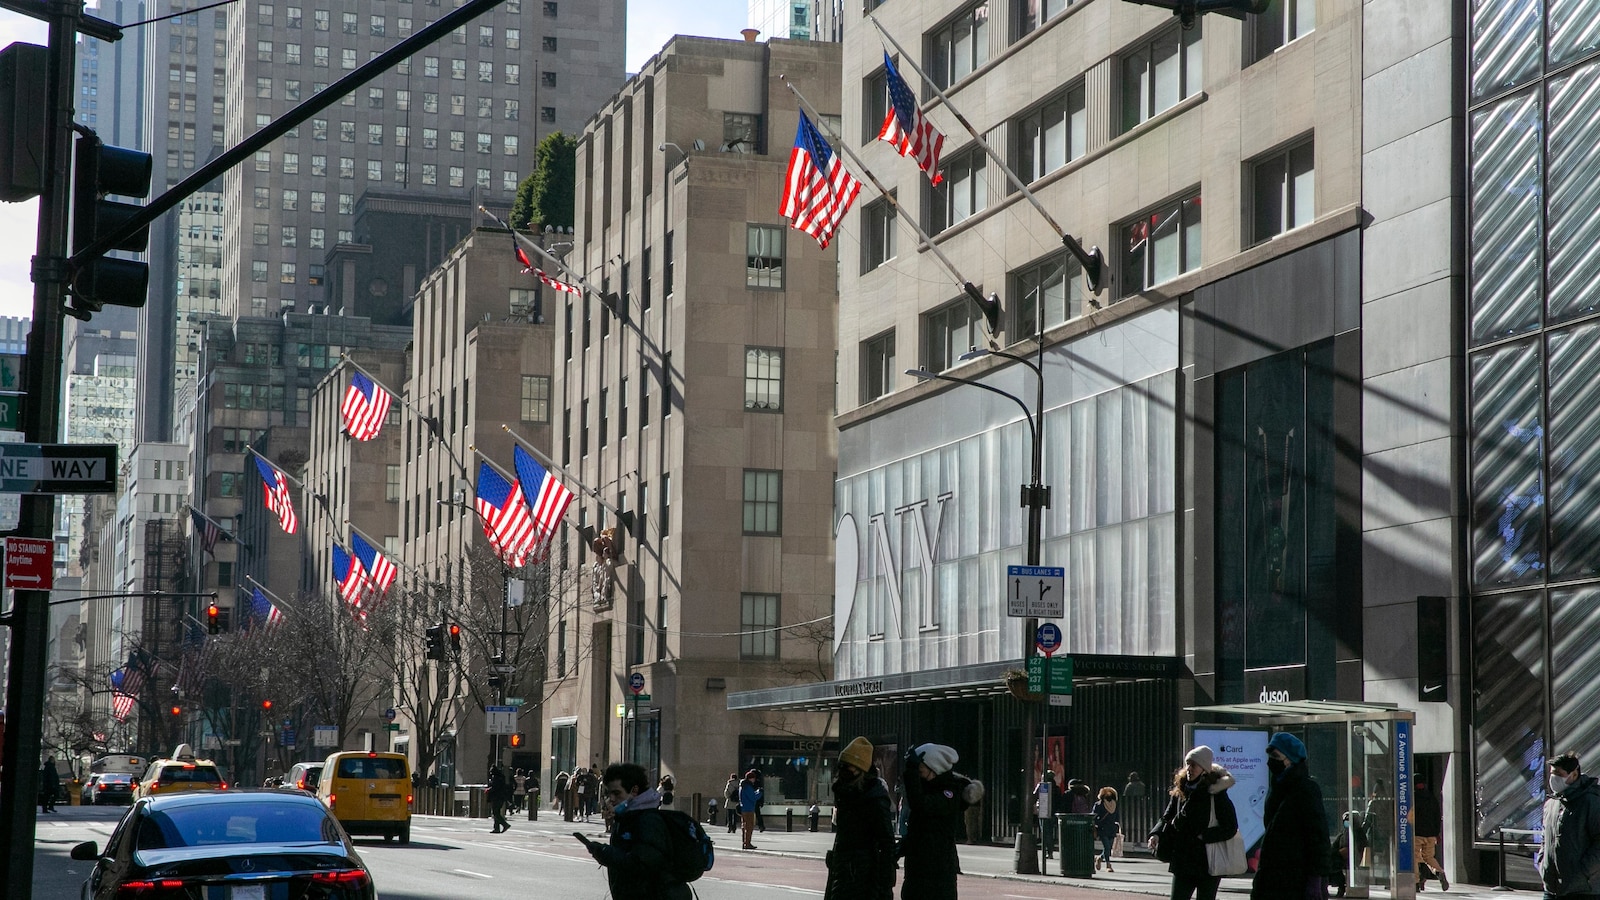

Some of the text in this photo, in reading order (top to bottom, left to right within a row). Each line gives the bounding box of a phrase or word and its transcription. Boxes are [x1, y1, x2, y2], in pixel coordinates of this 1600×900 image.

[51, 460, 97, 479] WAY
[8, 543, 47, 554] NO STANDING
[9, 555, 33, 566] Anytime
[869, 491, 953, 641] NY
[1033, 568, 1052, 576] LANES
[1074, 660, 1131, 670] VICTORIA'S
[1132, 662, 1166, 671] SECRET
[793, 741, 821, 751] LEGO
[1226, 745, 1243, 753] Card
[1398, 740, 1406, 772] Avenue
[1400, 781, 1408, 803] West
[1400, 805, 1407, 816] 52
[1400, 817, 1408, 843] Street
